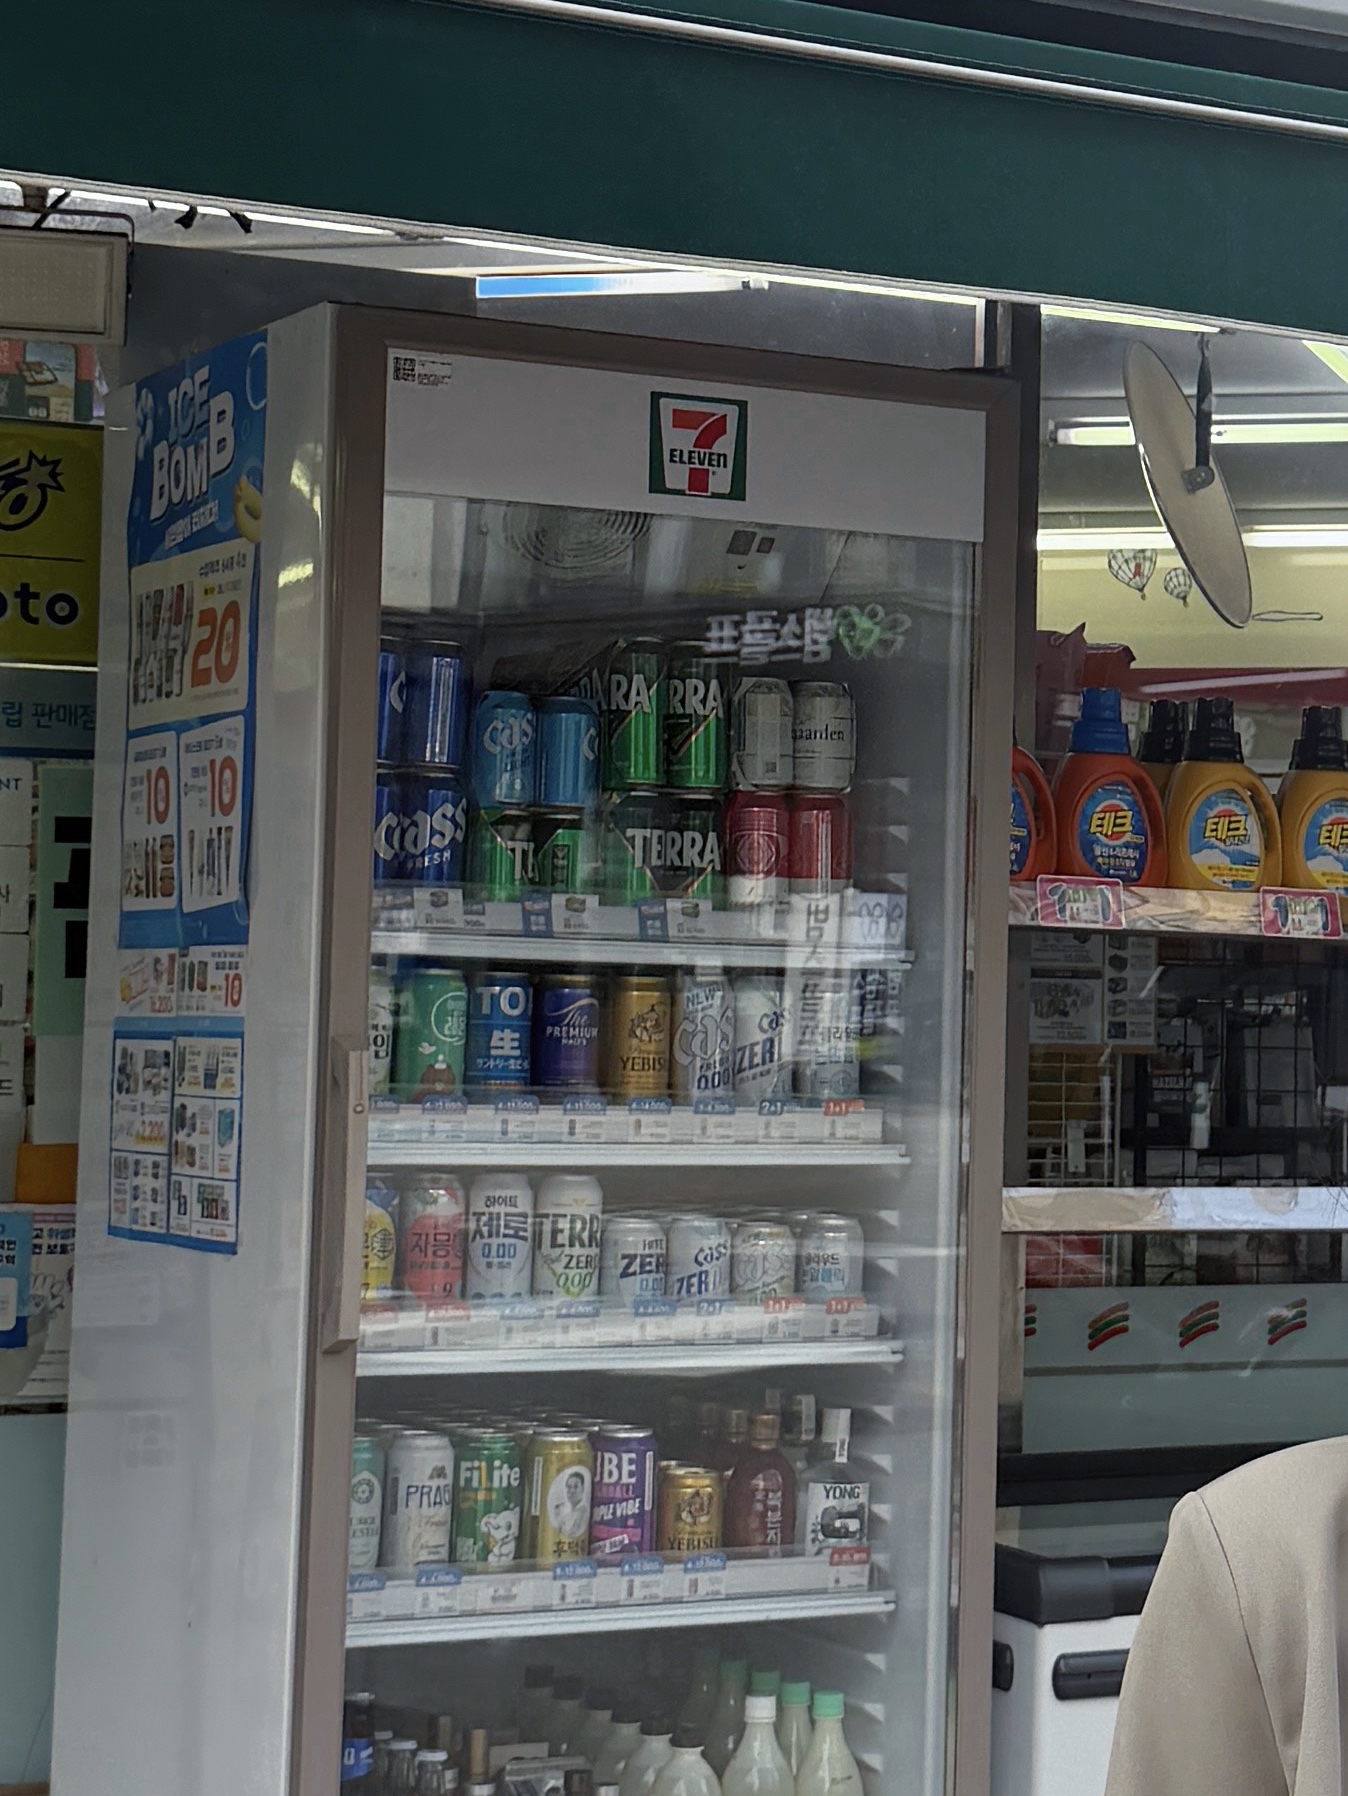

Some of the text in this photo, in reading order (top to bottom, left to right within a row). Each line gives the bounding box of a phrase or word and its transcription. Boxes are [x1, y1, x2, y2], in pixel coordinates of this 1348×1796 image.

[168, 364, 210, 445] ICE
[150, 390, 235, 522] BOMB
[191, 600, 241, 688] 20
[145, 766, 170, 825] 10
[209, 755, 238, 817] 10
[1090, 809, 1133, 836] 테크
[1204, 814, 1248, 844] 테크
[625, 827, 722, 873] TERRA
[225, 972, 243, 1008] 10
[490, 1029, 522, 1057] 生
[472, 1211, 530, 1243] 제로
[537, 1213, 604, 1252] TERR
[823, 1485, 861, 1500] YONG
